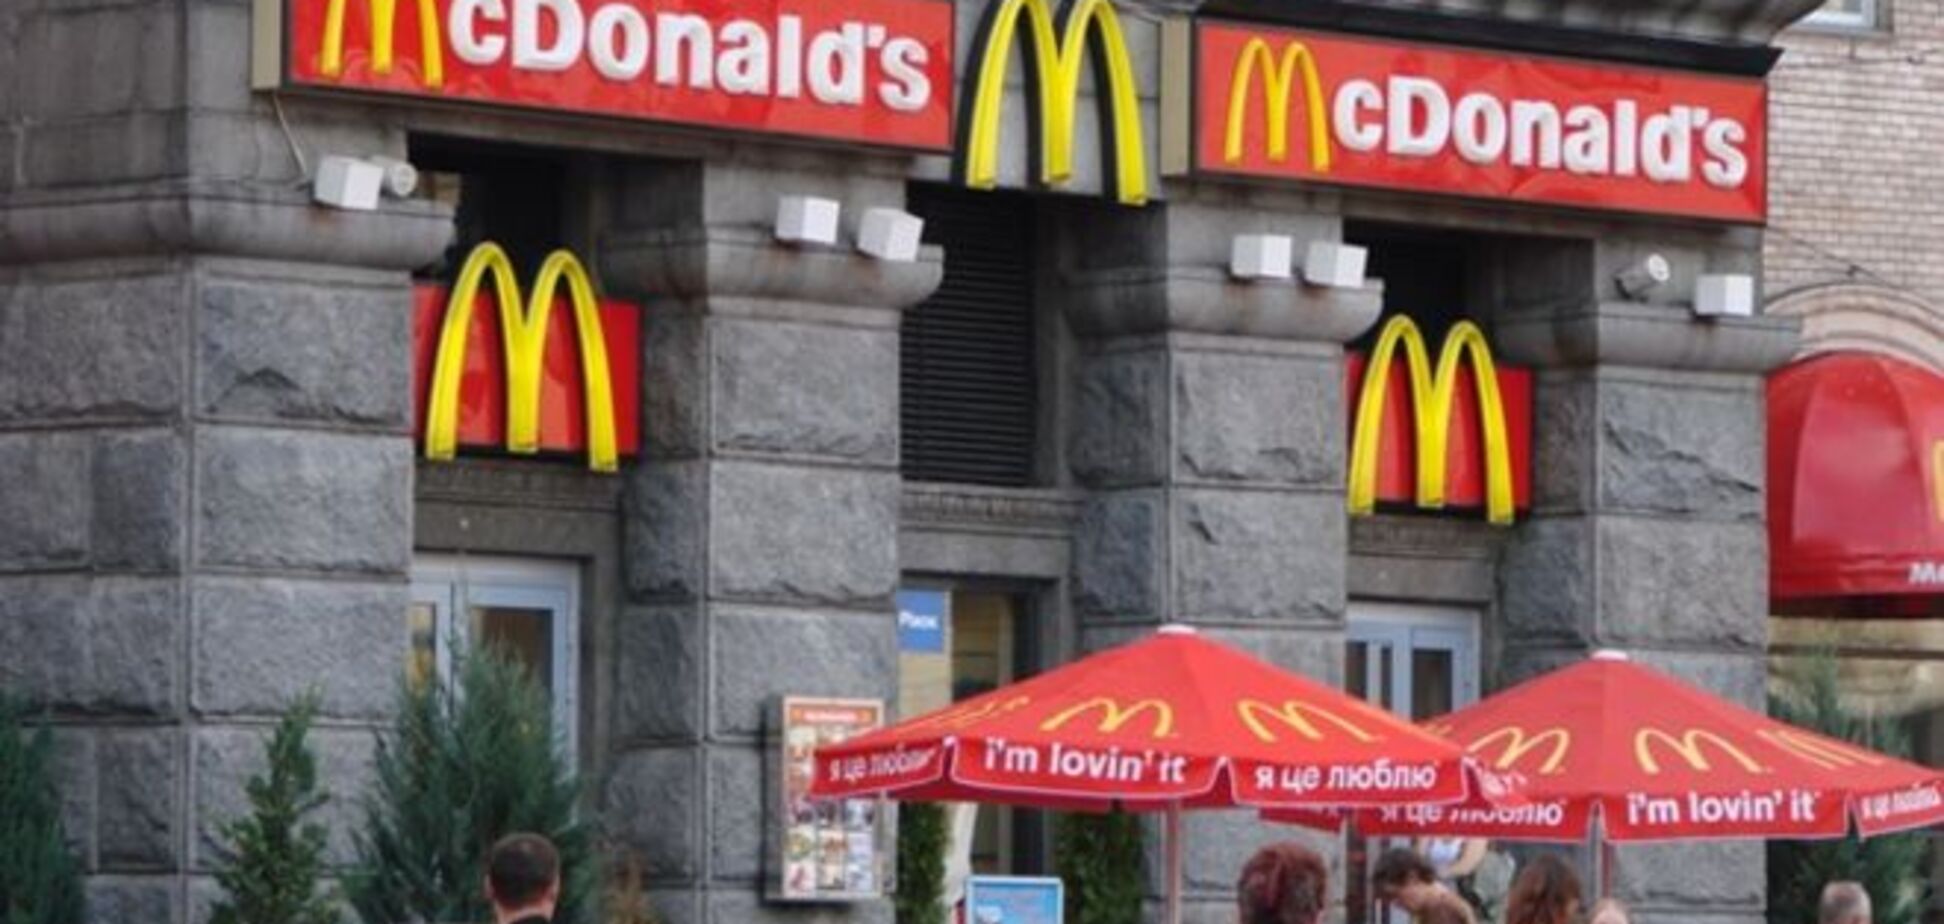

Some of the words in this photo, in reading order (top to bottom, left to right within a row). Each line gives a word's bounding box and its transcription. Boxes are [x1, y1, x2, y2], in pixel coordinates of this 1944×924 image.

[320, 0, 932, 112] McDonald's
[1224, 37, 1748, 189] McDonald's
[984, 737, 1039, 773] i'm
[1050, 742, 1153, 783] lovin'
[1159, 752, 1187, 783] it
[1255, 765, 1275, 789] я
[1280, 765, 1321, 794] це
[1327, 757, 1437, 790] люблю
[1626, 791, 1680, 825] i'm
[1688, 790, 1783, 823] lovin'
[1789, 788, 1815, 822] it
